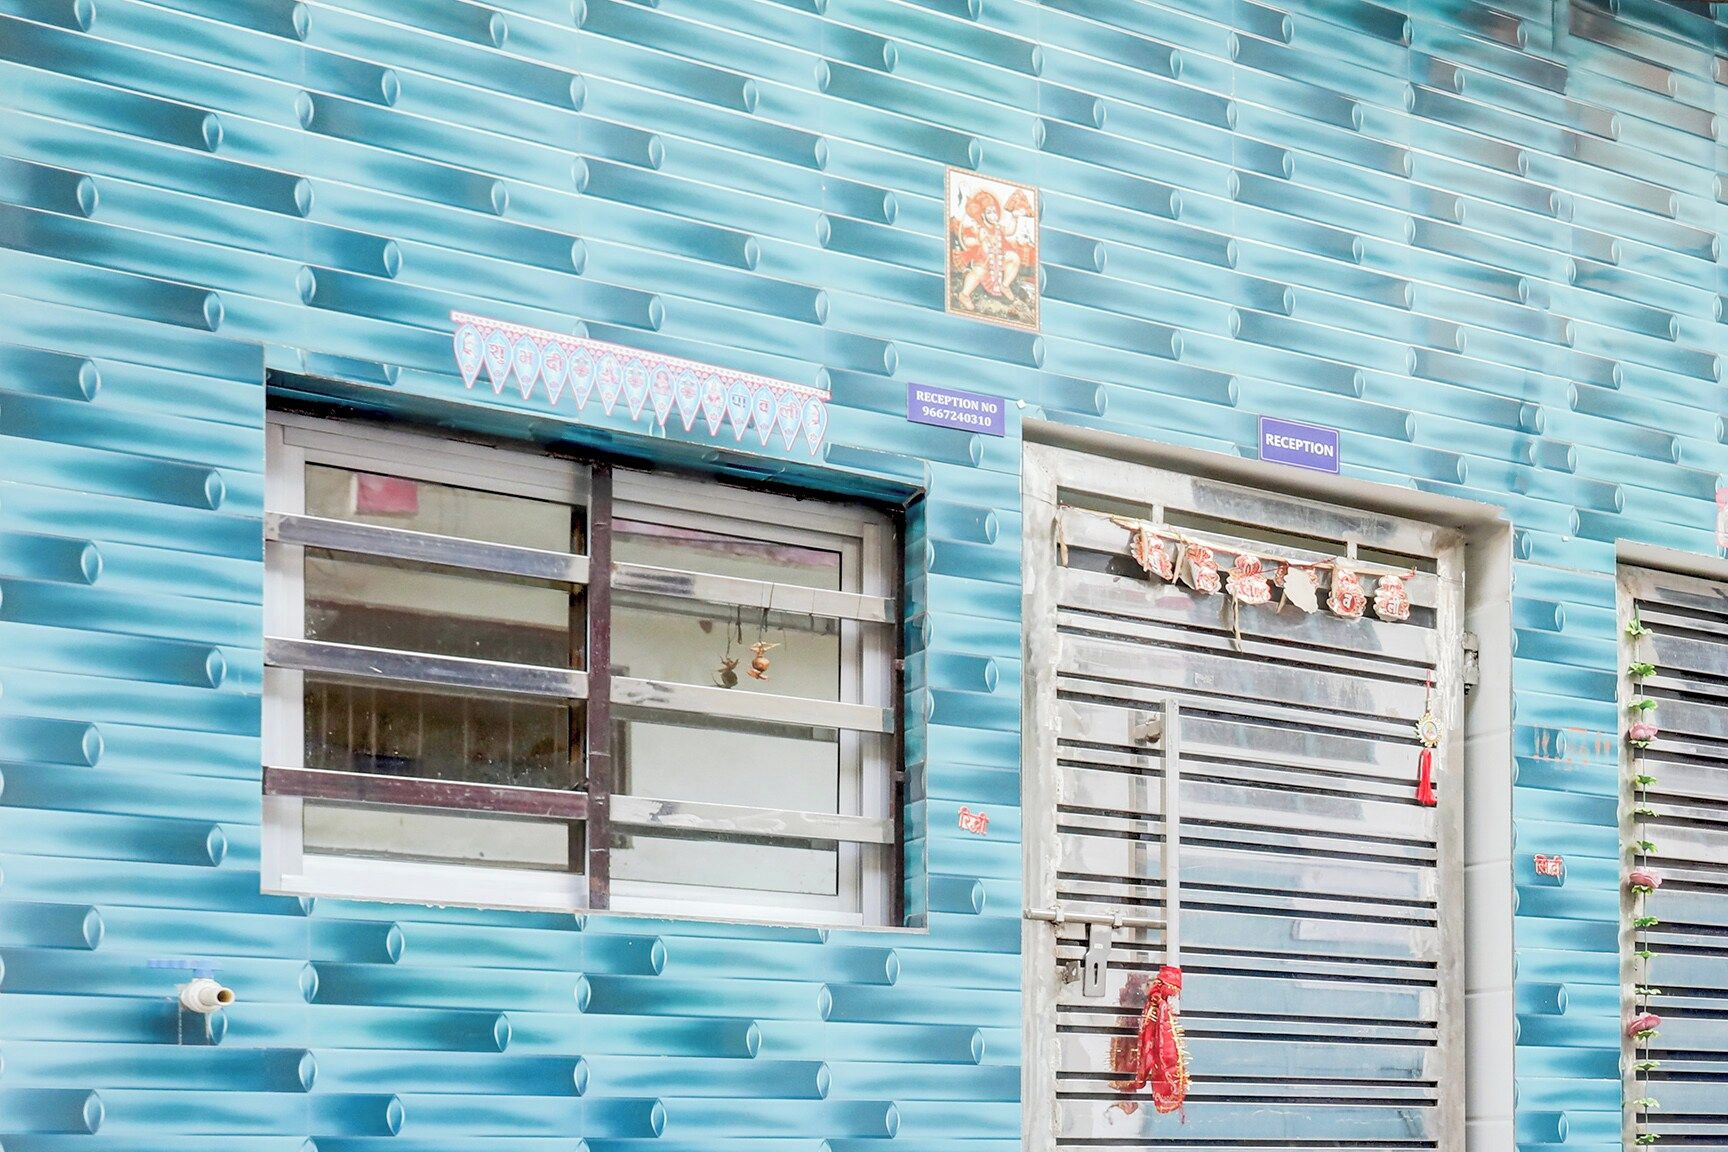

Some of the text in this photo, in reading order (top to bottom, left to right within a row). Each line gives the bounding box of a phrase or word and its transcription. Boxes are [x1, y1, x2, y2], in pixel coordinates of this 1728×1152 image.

[916, 390, 998, 414] RECEPTION NO
[922, 405, 992, 427] 9667240310
[1264, 433, 1334, 459] RECEPTION
